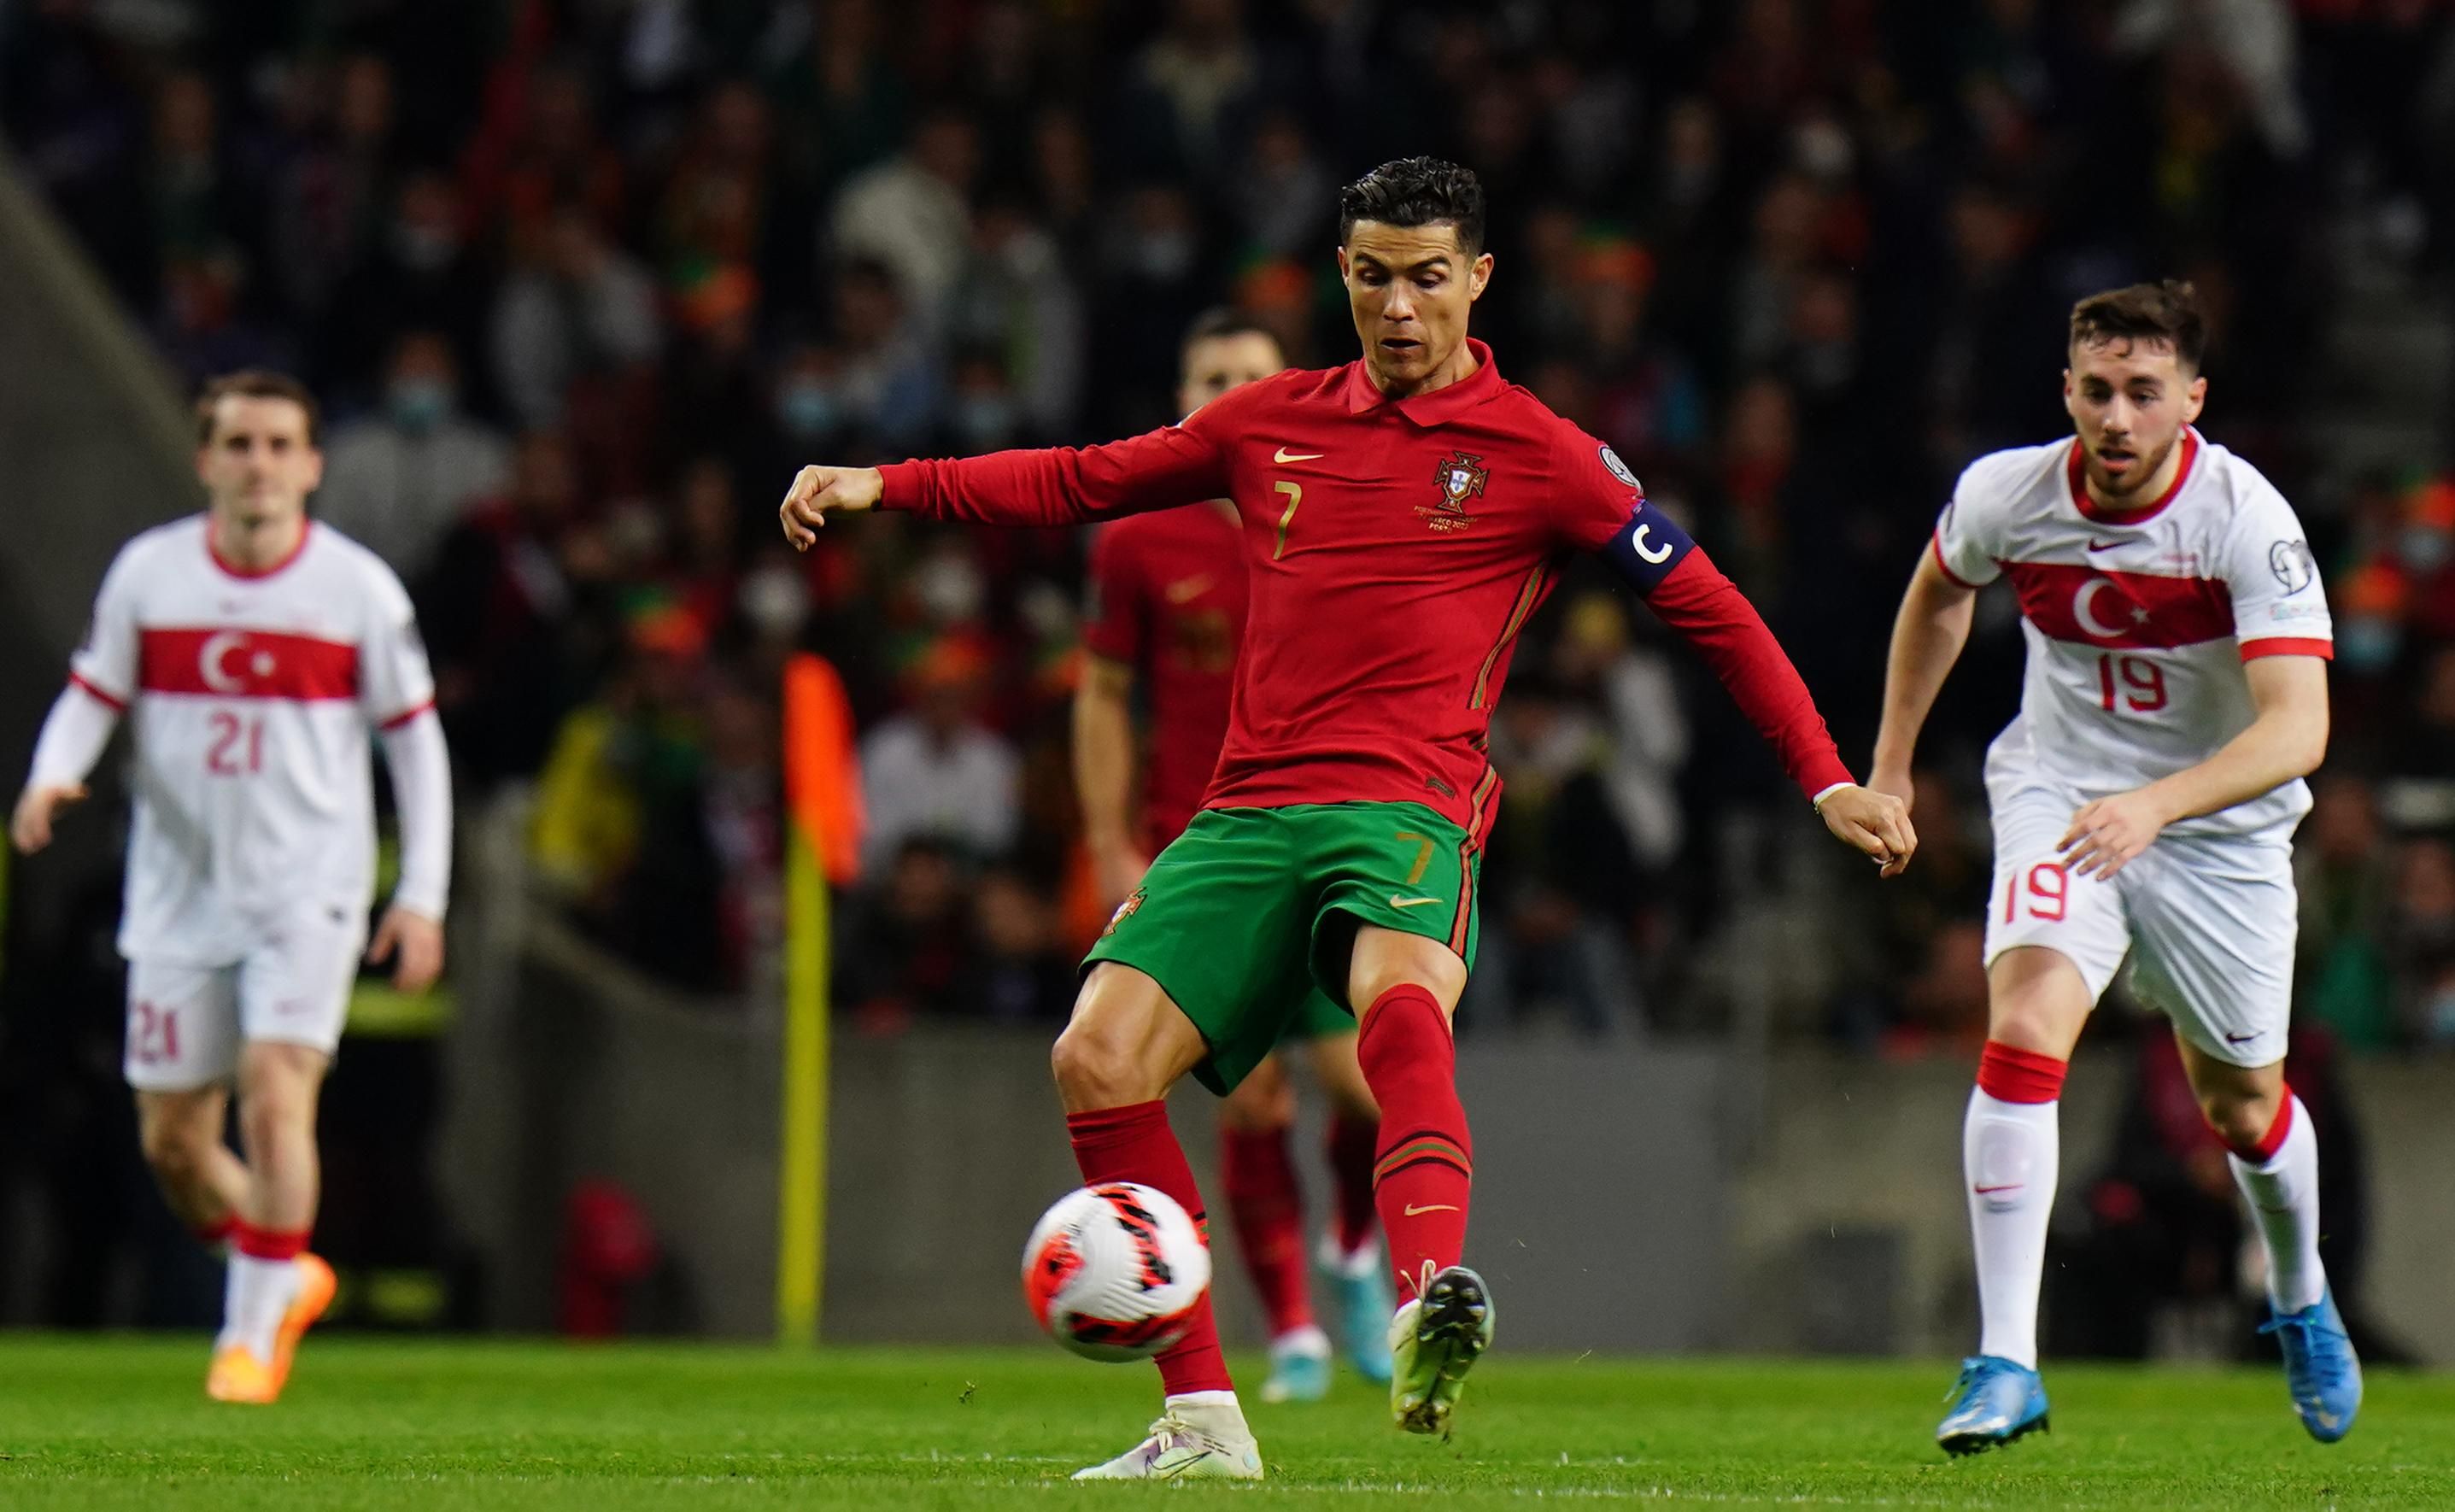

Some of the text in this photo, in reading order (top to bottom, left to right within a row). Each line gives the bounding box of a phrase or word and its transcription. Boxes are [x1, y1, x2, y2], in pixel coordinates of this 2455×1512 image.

[1273, 481, 1303, 560] 7
[1632, 523, 1673, 565] C
[2099, 653, 2167, 712] 19
[208, 712, 264, 775] 21
[1396, 831, 1434, 885] 7
[2004, 863, 2068, 924] 19
[135, 1001, 179, 1062] 21
